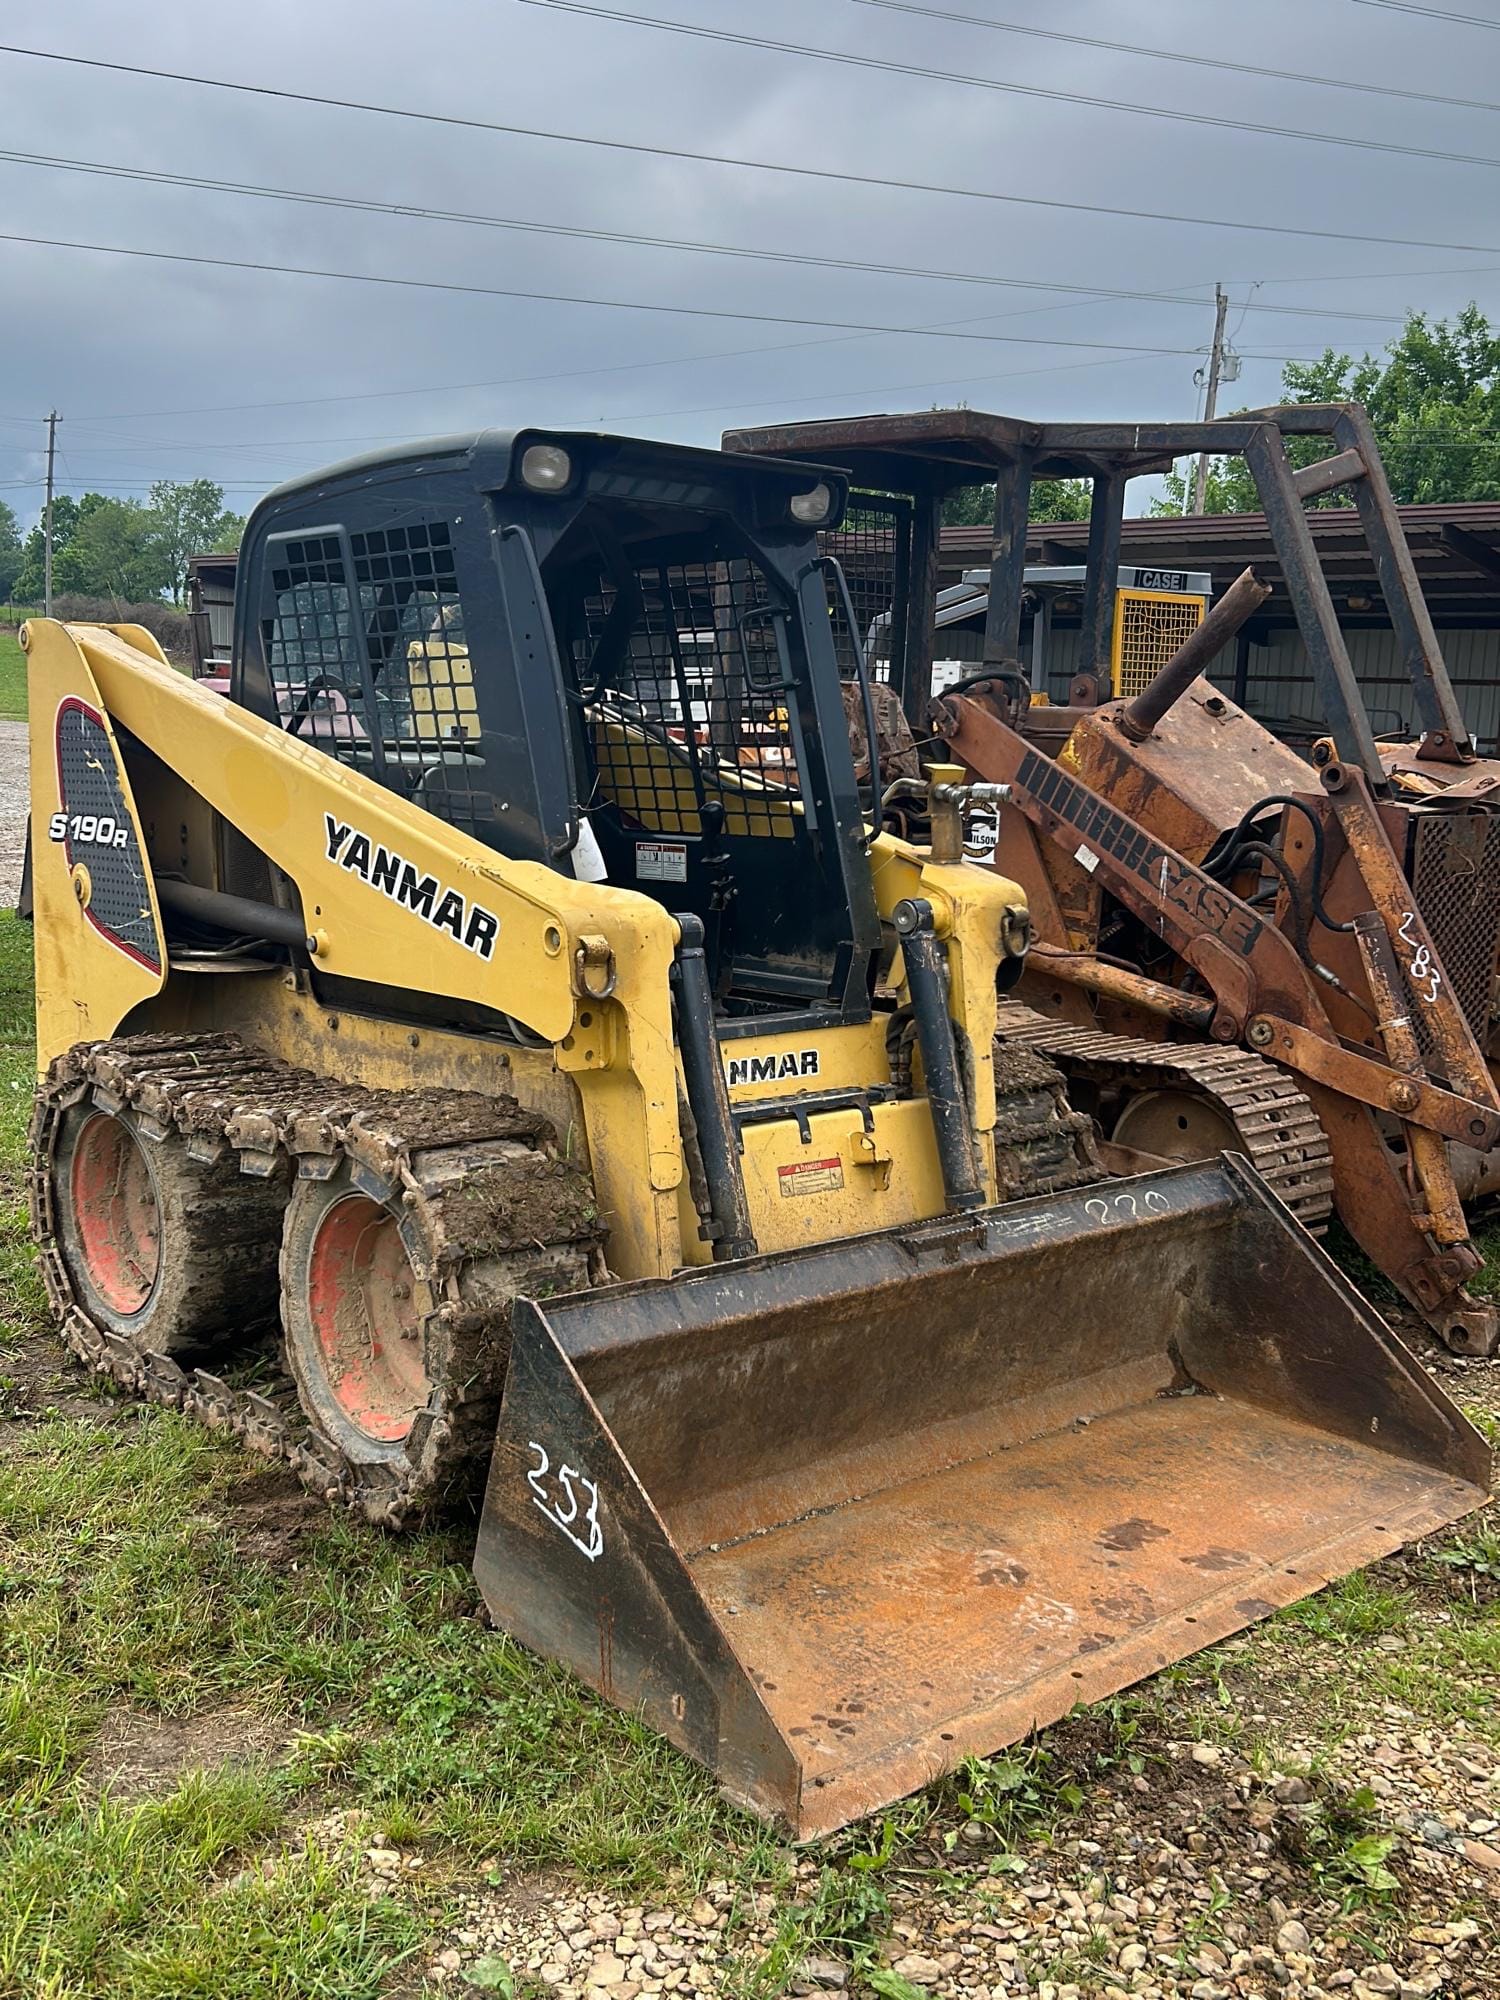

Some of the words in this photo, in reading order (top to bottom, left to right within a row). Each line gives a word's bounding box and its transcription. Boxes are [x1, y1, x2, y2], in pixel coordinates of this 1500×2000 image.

[1142, 571, 1180, 590] CASE
[324, 813, 499, 961] YANMAR
[1148, 855, 1263, 955] CASE
[1398, 912, 1441, 1003] 283
